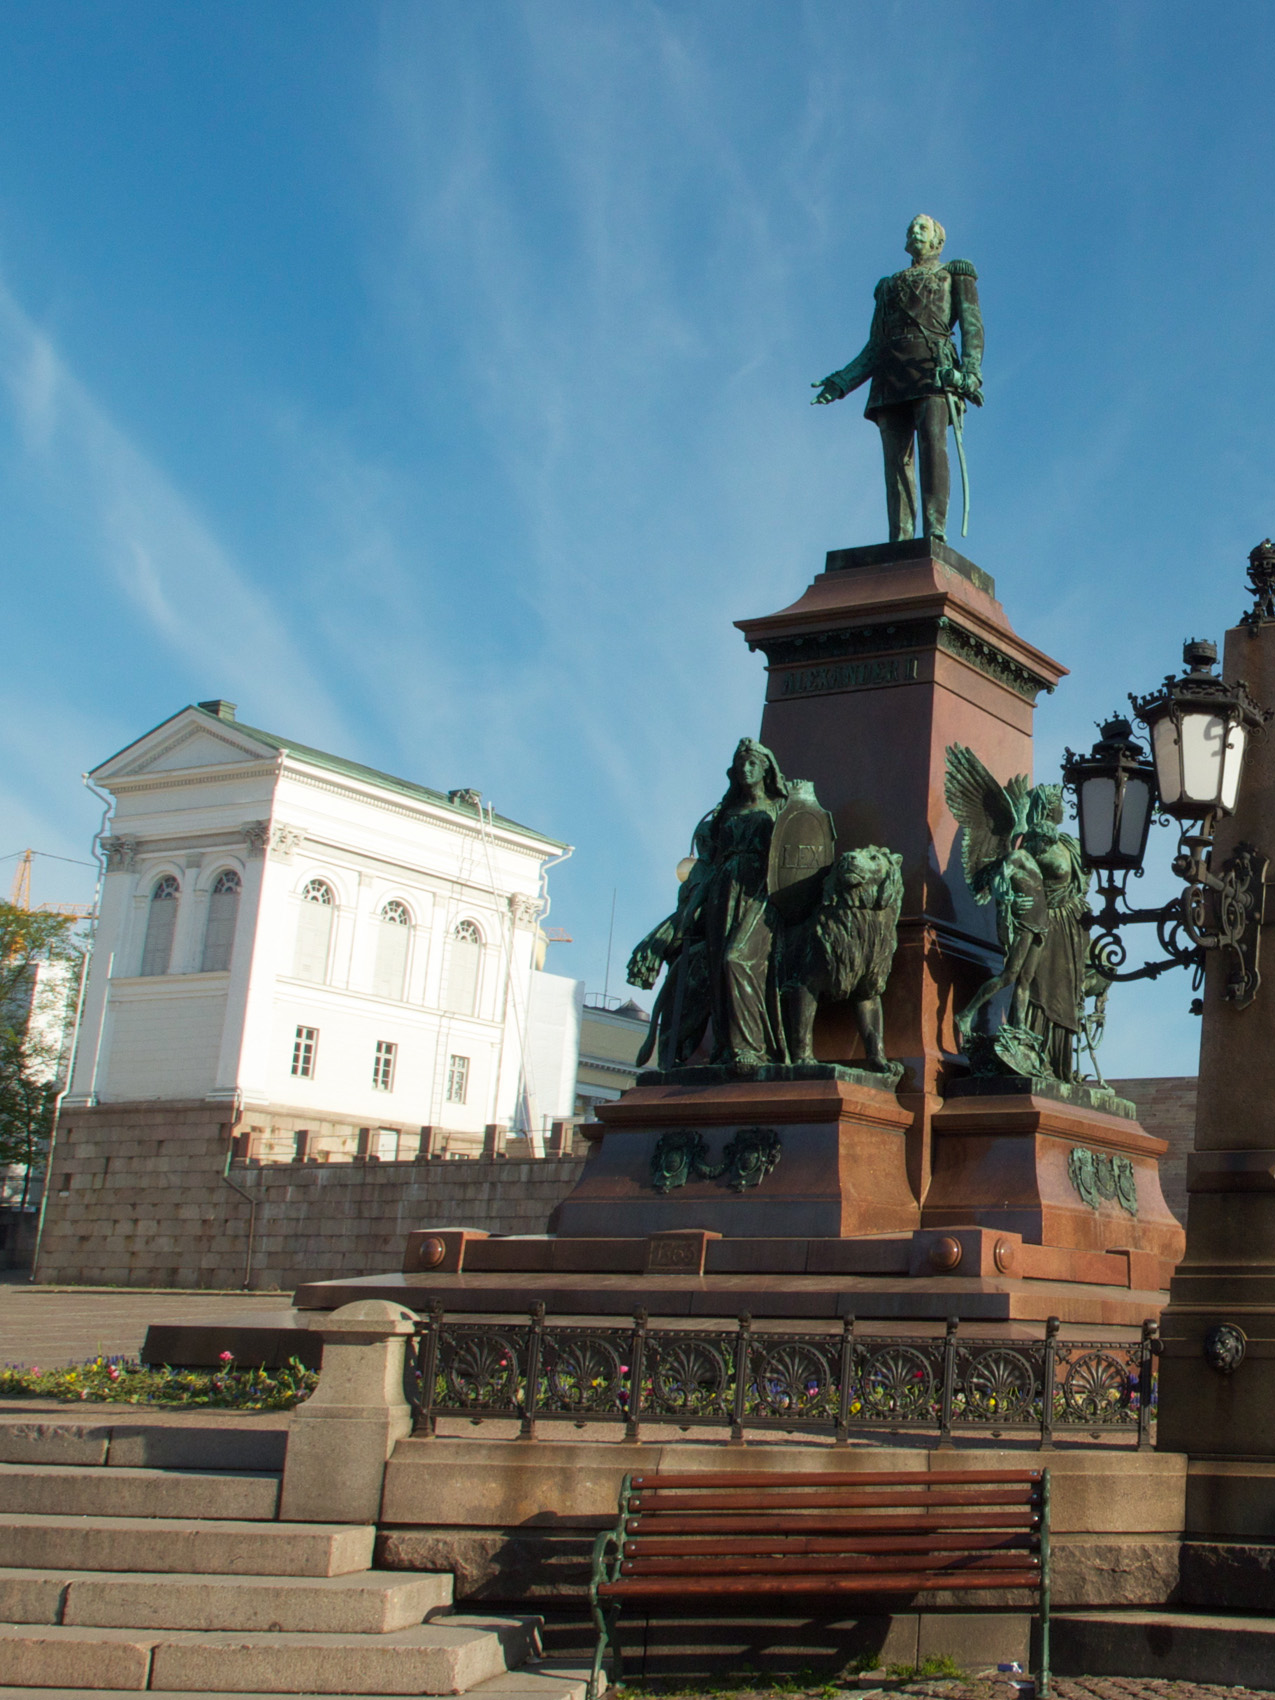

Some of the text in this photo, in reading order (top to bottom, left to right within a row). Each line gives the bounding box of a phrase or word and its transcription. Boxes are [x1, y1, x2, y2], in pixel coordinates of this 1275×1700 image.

[781, 657, 918, 695] ALEXANDER II
[782, 845, 823, 868] LEX
